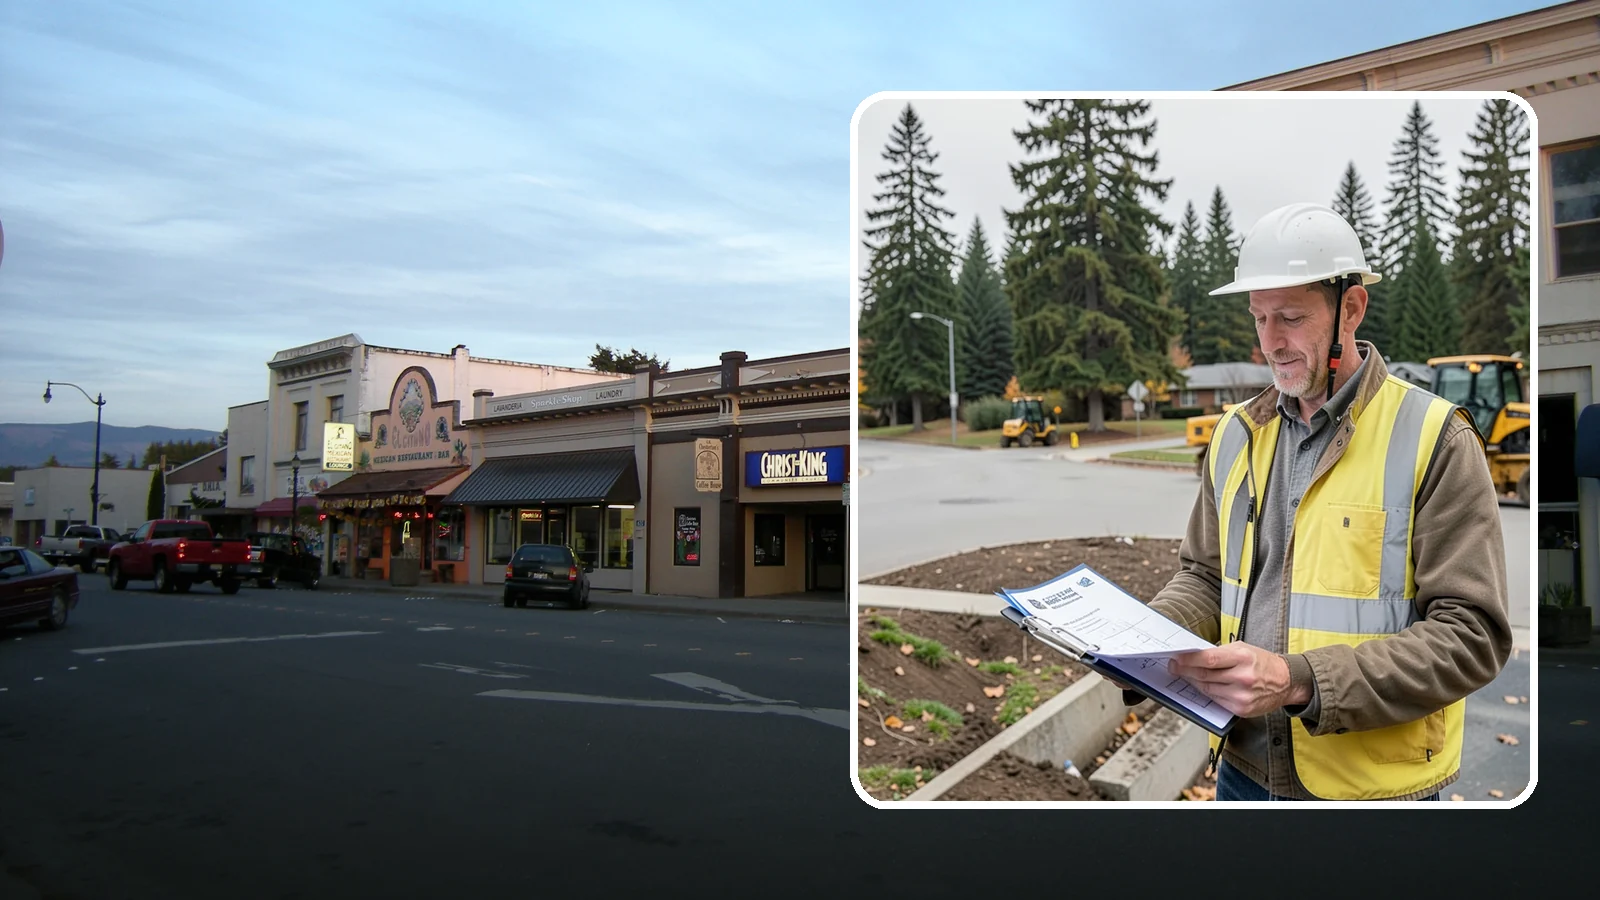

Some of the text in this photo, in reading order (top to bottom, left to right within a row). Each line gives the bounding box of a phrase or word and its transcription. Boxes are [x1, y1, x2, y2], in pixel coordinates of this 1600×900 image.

[493, 389, 624, 413] LAVANDERIA Sparkle Shop LAUNDRY
[373, 454, 396, 464] MEXICAN
[397, 451, 433, 462] RESTAURANT
[437, 450, 450, 459] BAR
